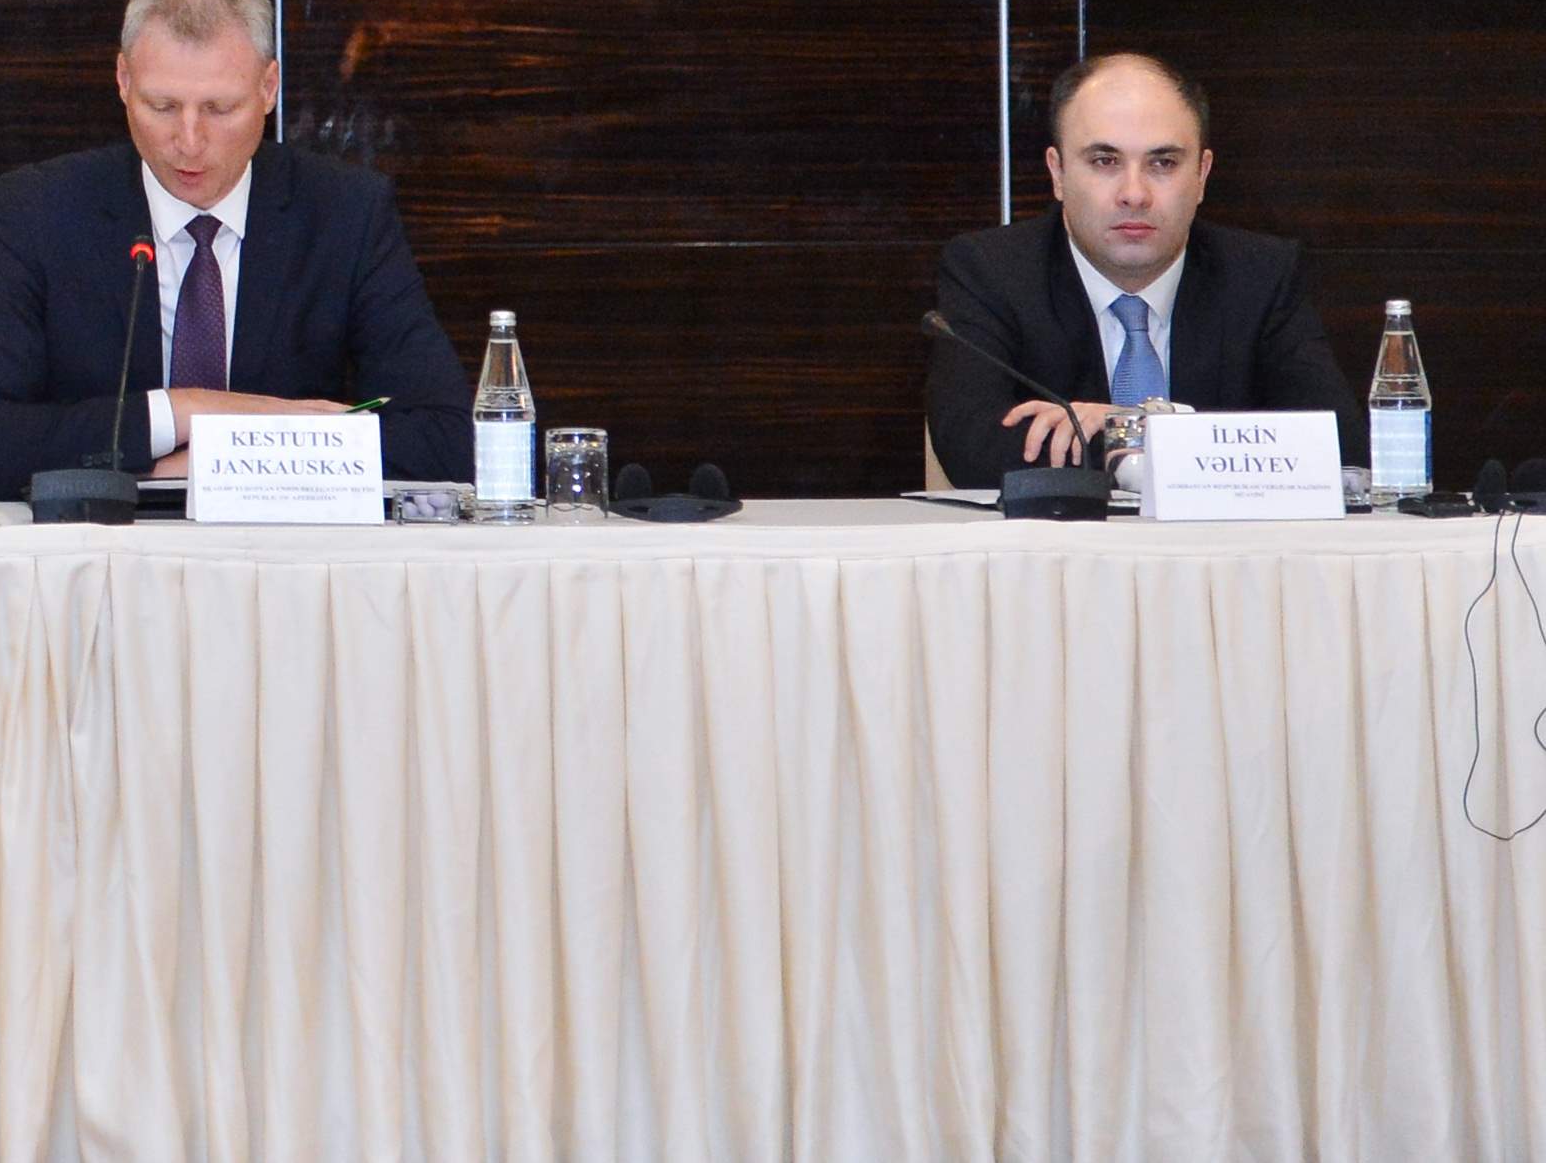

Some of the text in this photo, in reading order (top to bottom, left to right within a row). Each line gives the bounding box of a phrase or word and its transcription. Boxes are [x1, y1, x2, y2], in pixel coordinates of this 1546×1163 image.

[230, 430, 344, 448] KESTUTIS
[1211, 423, 1277, 444] İLKİN
[211, 458, 366, 477] JANKAUSKAS
